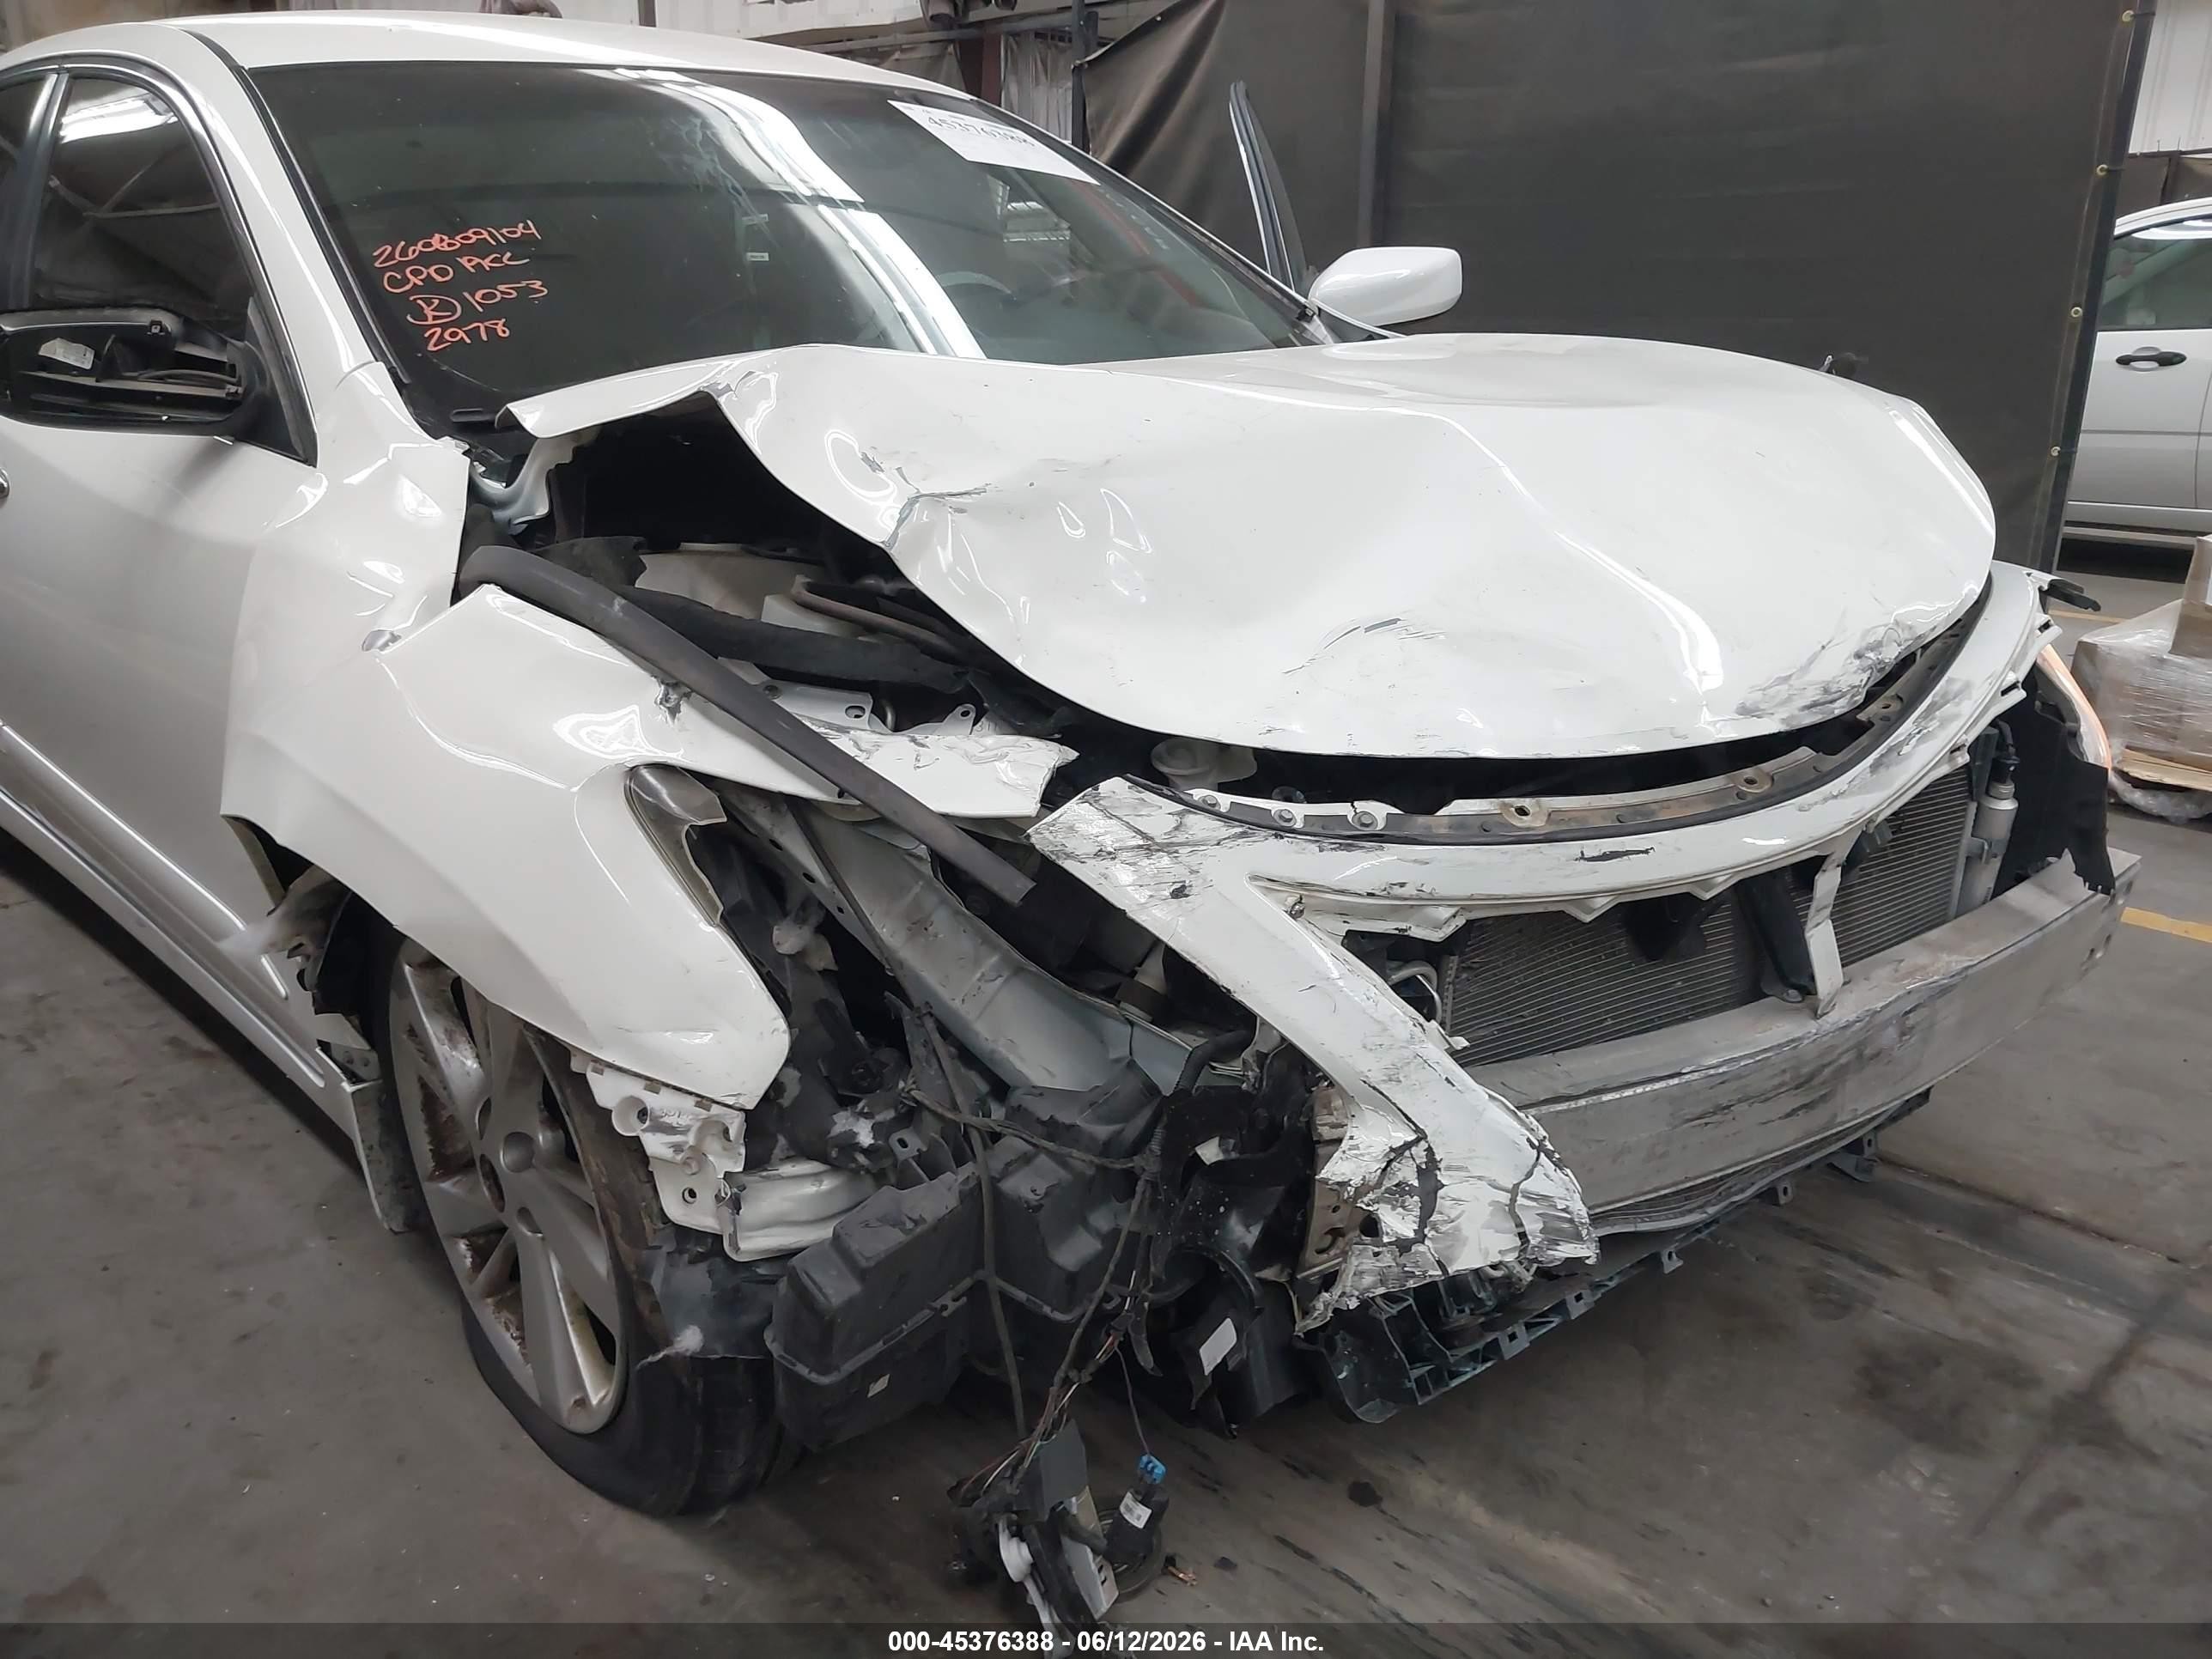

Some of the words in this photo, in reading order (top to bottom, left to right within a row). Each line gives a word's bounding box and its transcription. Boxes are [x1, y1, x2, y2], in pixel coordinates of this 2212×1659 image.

[383, 264, 454, 293] CPD
[462, 280, 549, 313] 1053
[423, 318, 511, 351] 2978
